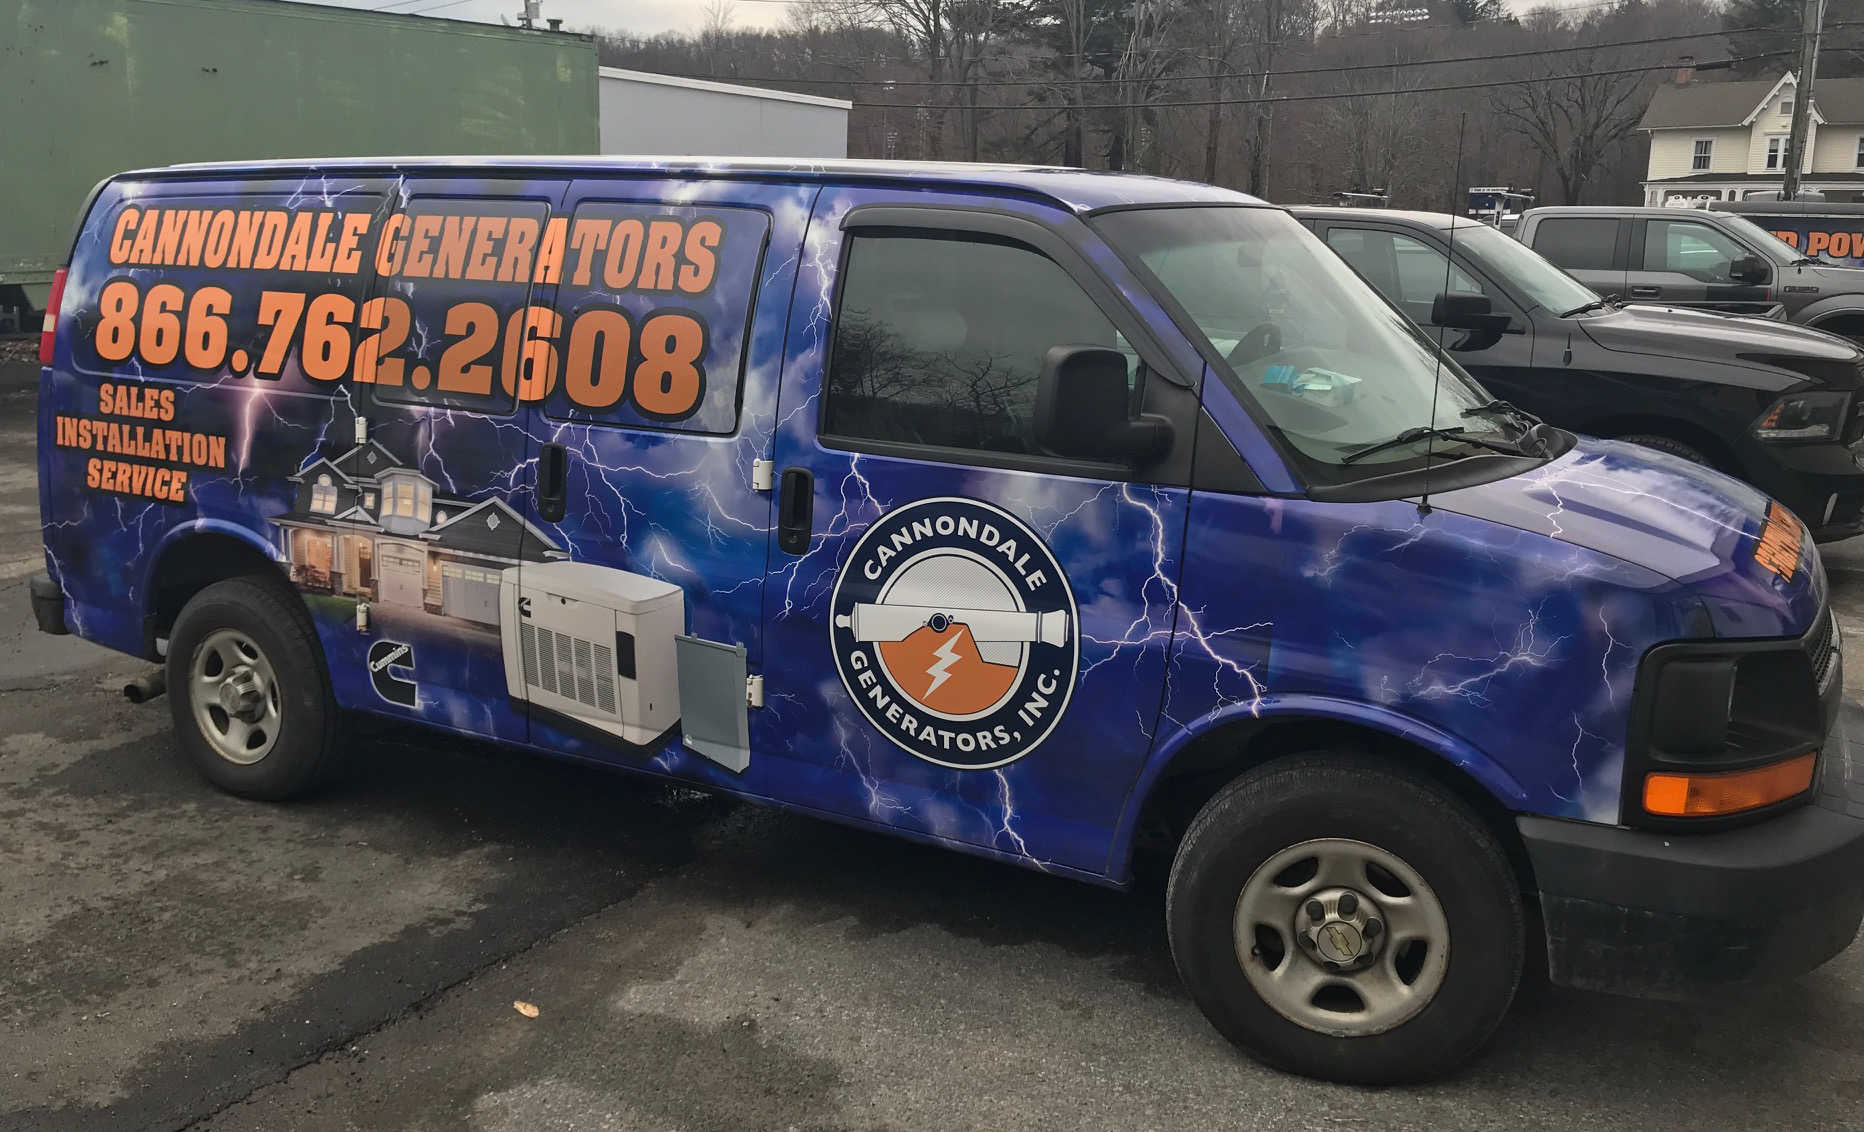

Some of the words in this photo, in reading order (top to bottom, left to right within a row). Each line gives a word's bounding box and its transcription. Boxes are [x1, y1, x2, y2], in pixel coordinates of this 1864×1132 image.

[109, 208, 372, 274] CANNONDALE
[374, 213, 722, 293] GENERATORS
[95, 281, 704, 415] 866.762.2608
[99, 383, 175, 422] SALES
[56, 416, 226, 469] INSTALLATION
[86, 457, 188, 502] SERVICE
[863, 515, 1048, 592] CANNONDALE
[369, 645, 409, 672] Cummins
[850, 650, 1022, 752] GENERATORS,
[1017, 668, 1061, 727] INC.
